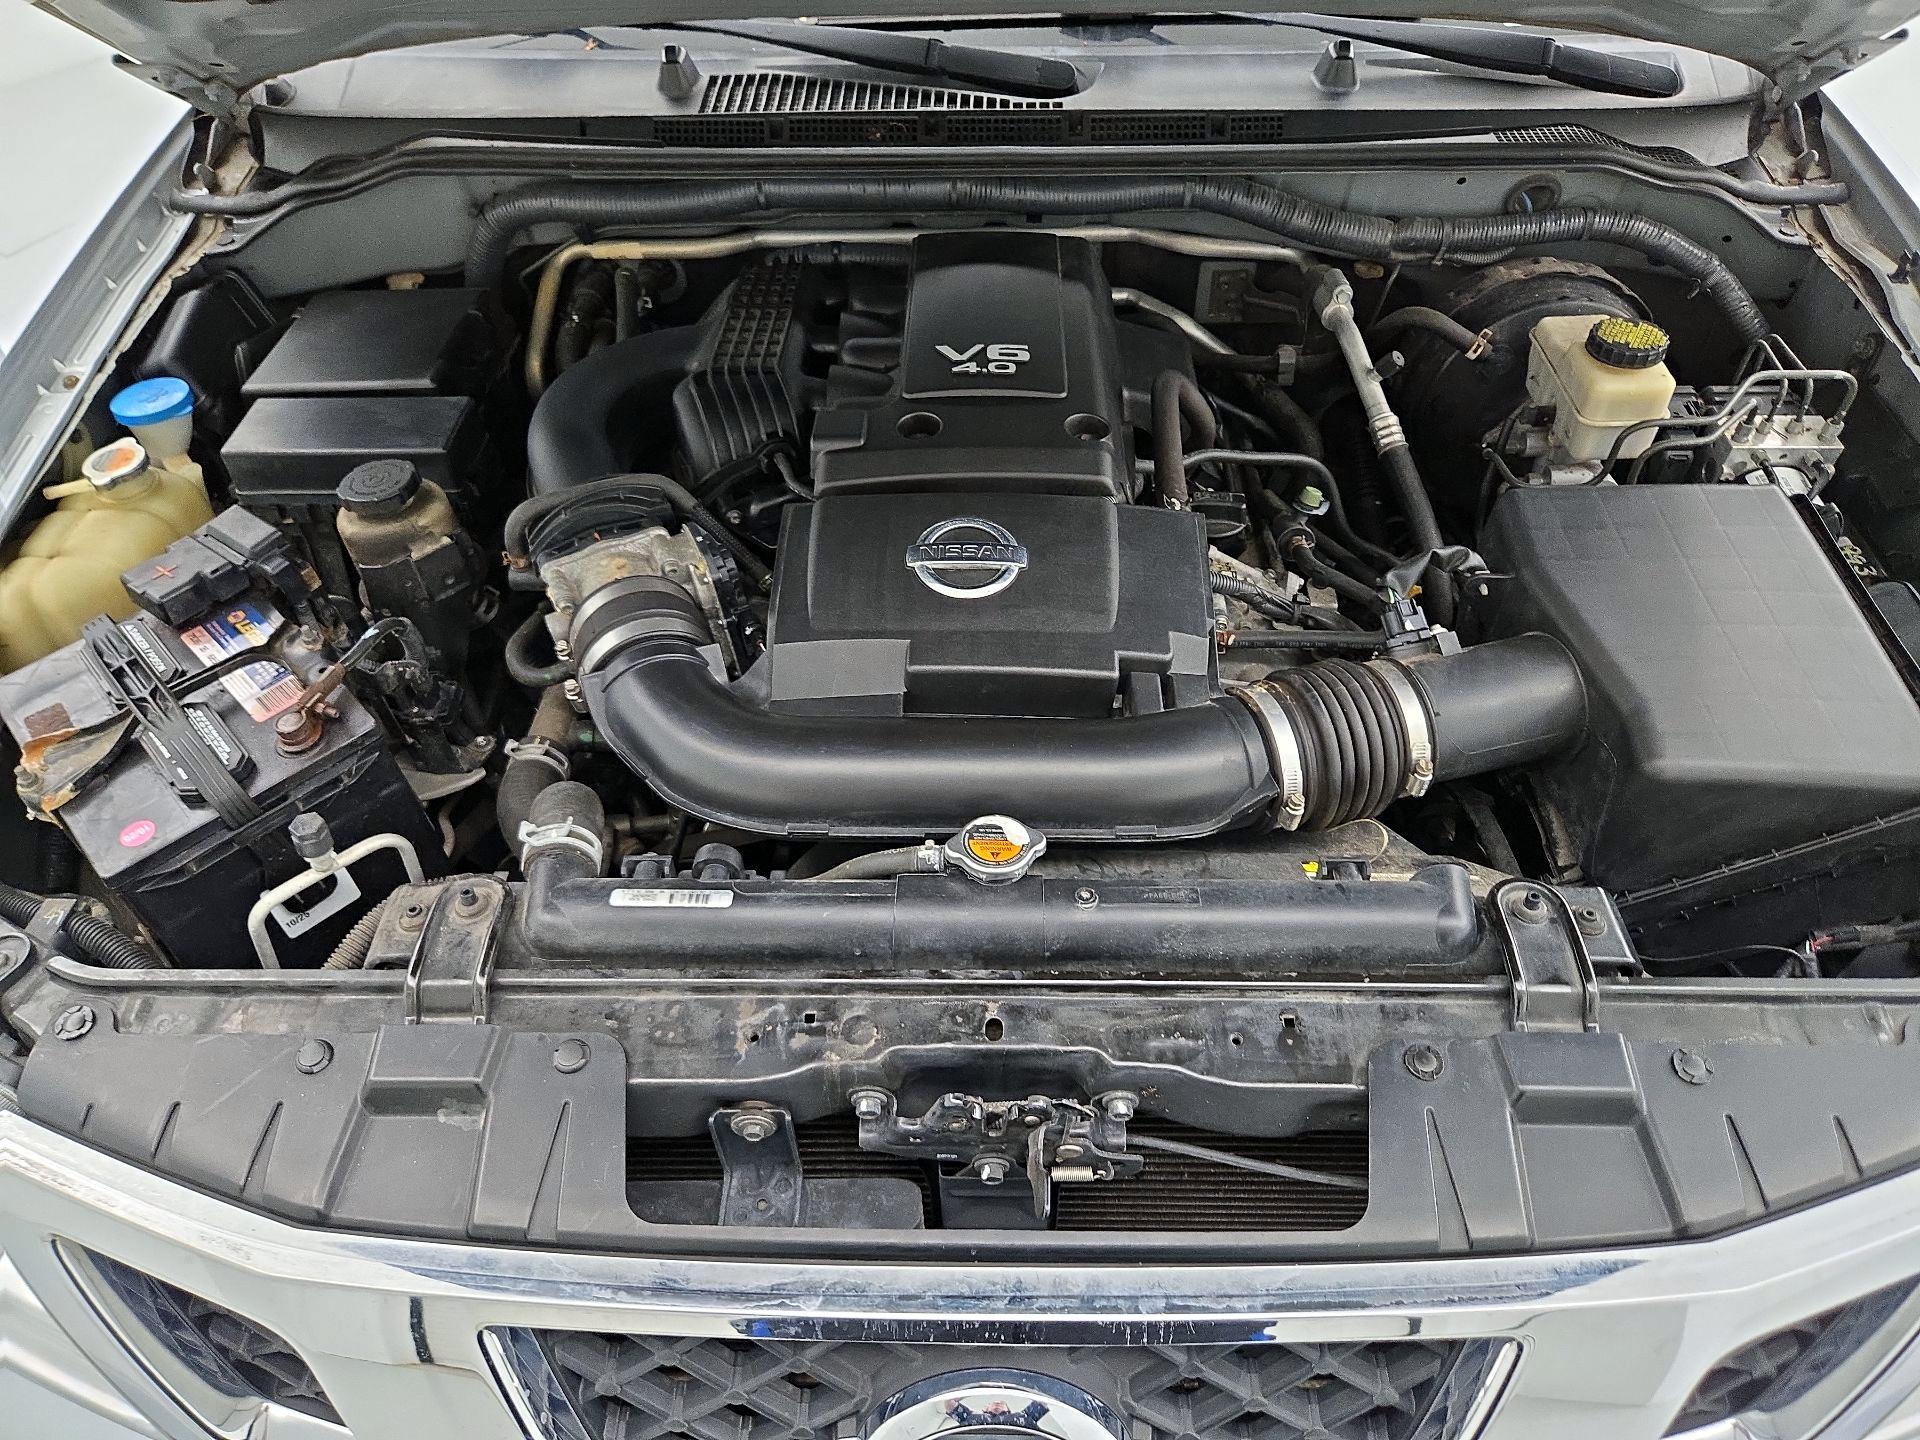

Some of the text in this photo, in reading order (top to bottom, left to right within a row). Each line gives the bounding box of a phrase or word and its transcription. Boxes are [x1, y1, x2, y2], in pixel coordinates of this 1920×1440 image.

[934, 343, 1031, 362] V6
[951, 361, 1017, 375] 4.0
[919, 544, 1015, 560] NISSAN
